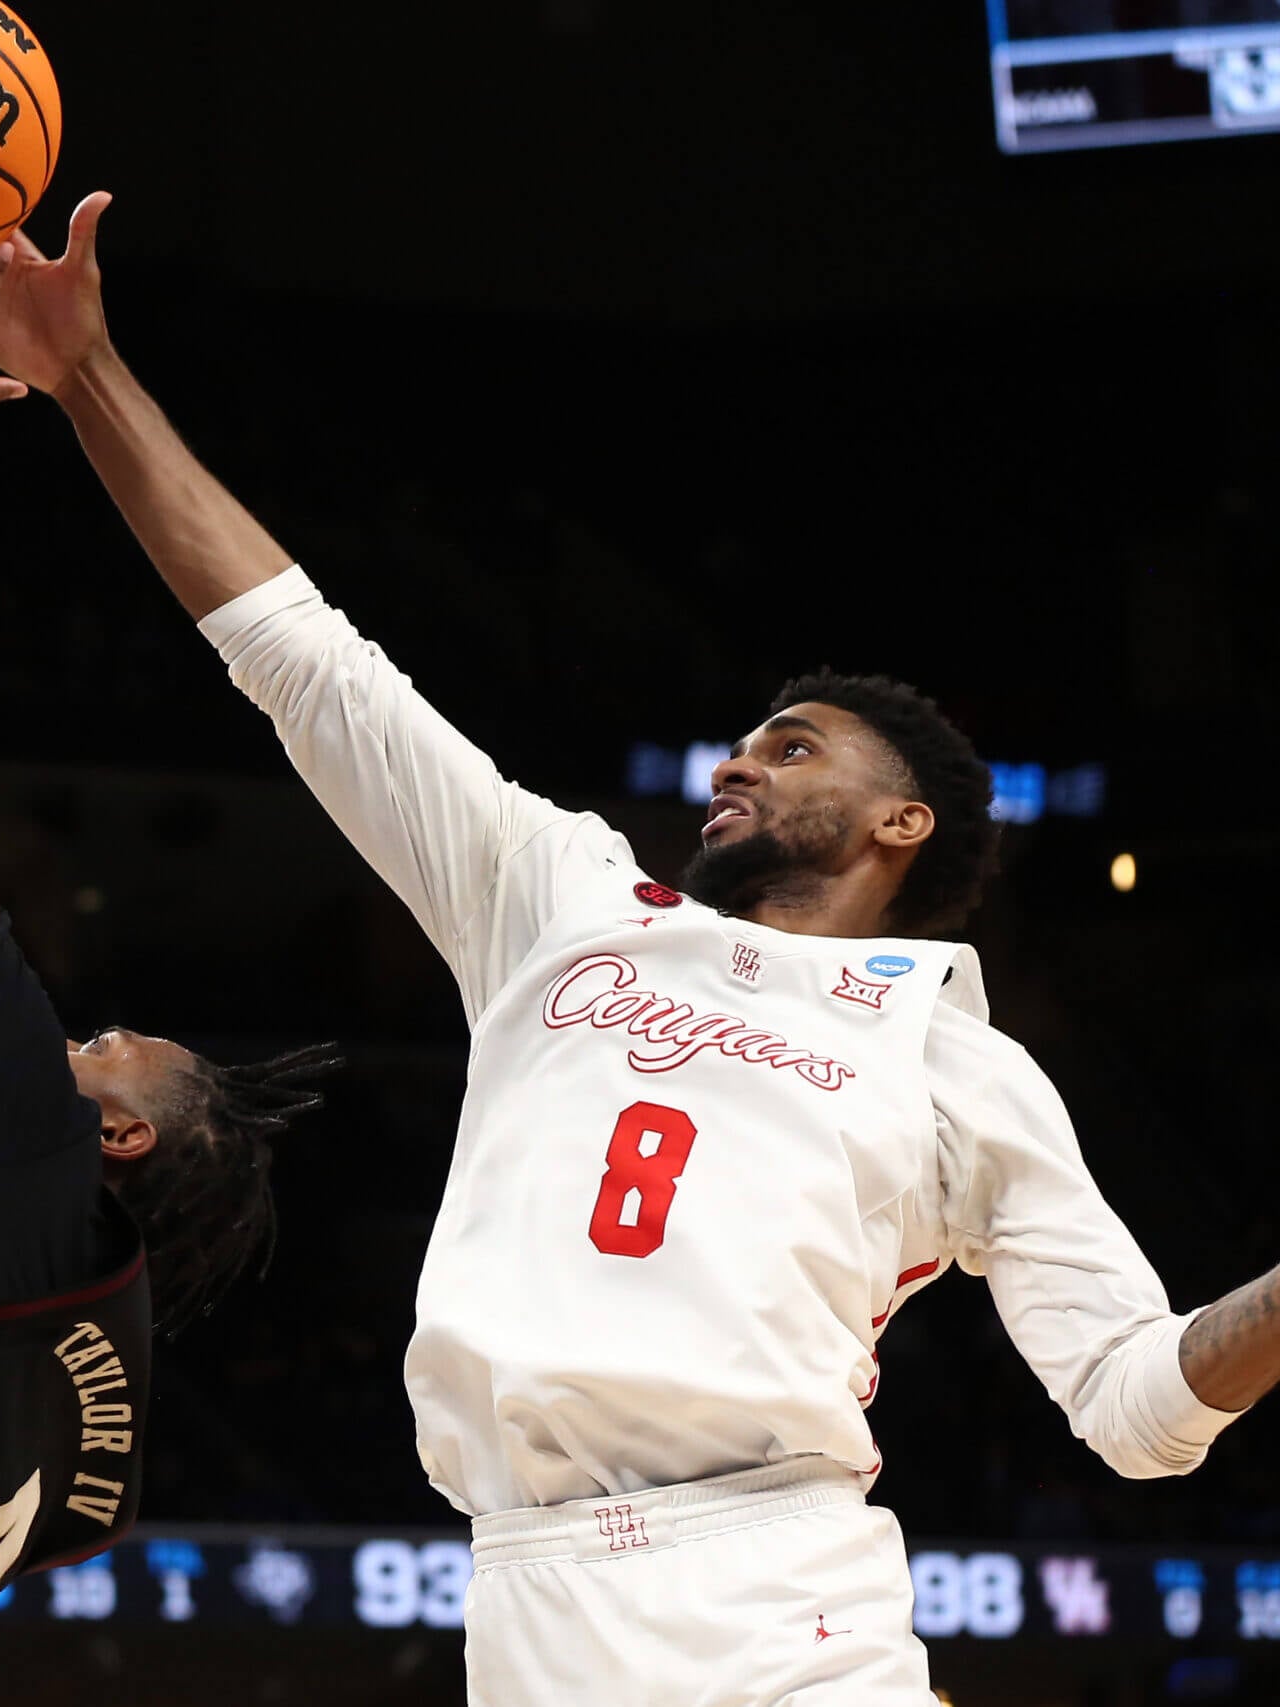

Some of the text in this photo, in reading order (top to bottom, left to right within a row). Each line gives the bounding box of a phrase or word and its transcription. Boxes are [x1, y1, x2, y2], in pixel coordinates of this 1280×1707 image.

[543, 952, 857, 1091] Cougars
[587, 1100, 698, 1258] 8
[54, 1321, 133, 1527] TAYLOR IV
[351, 1538, 470, 1629] 93
